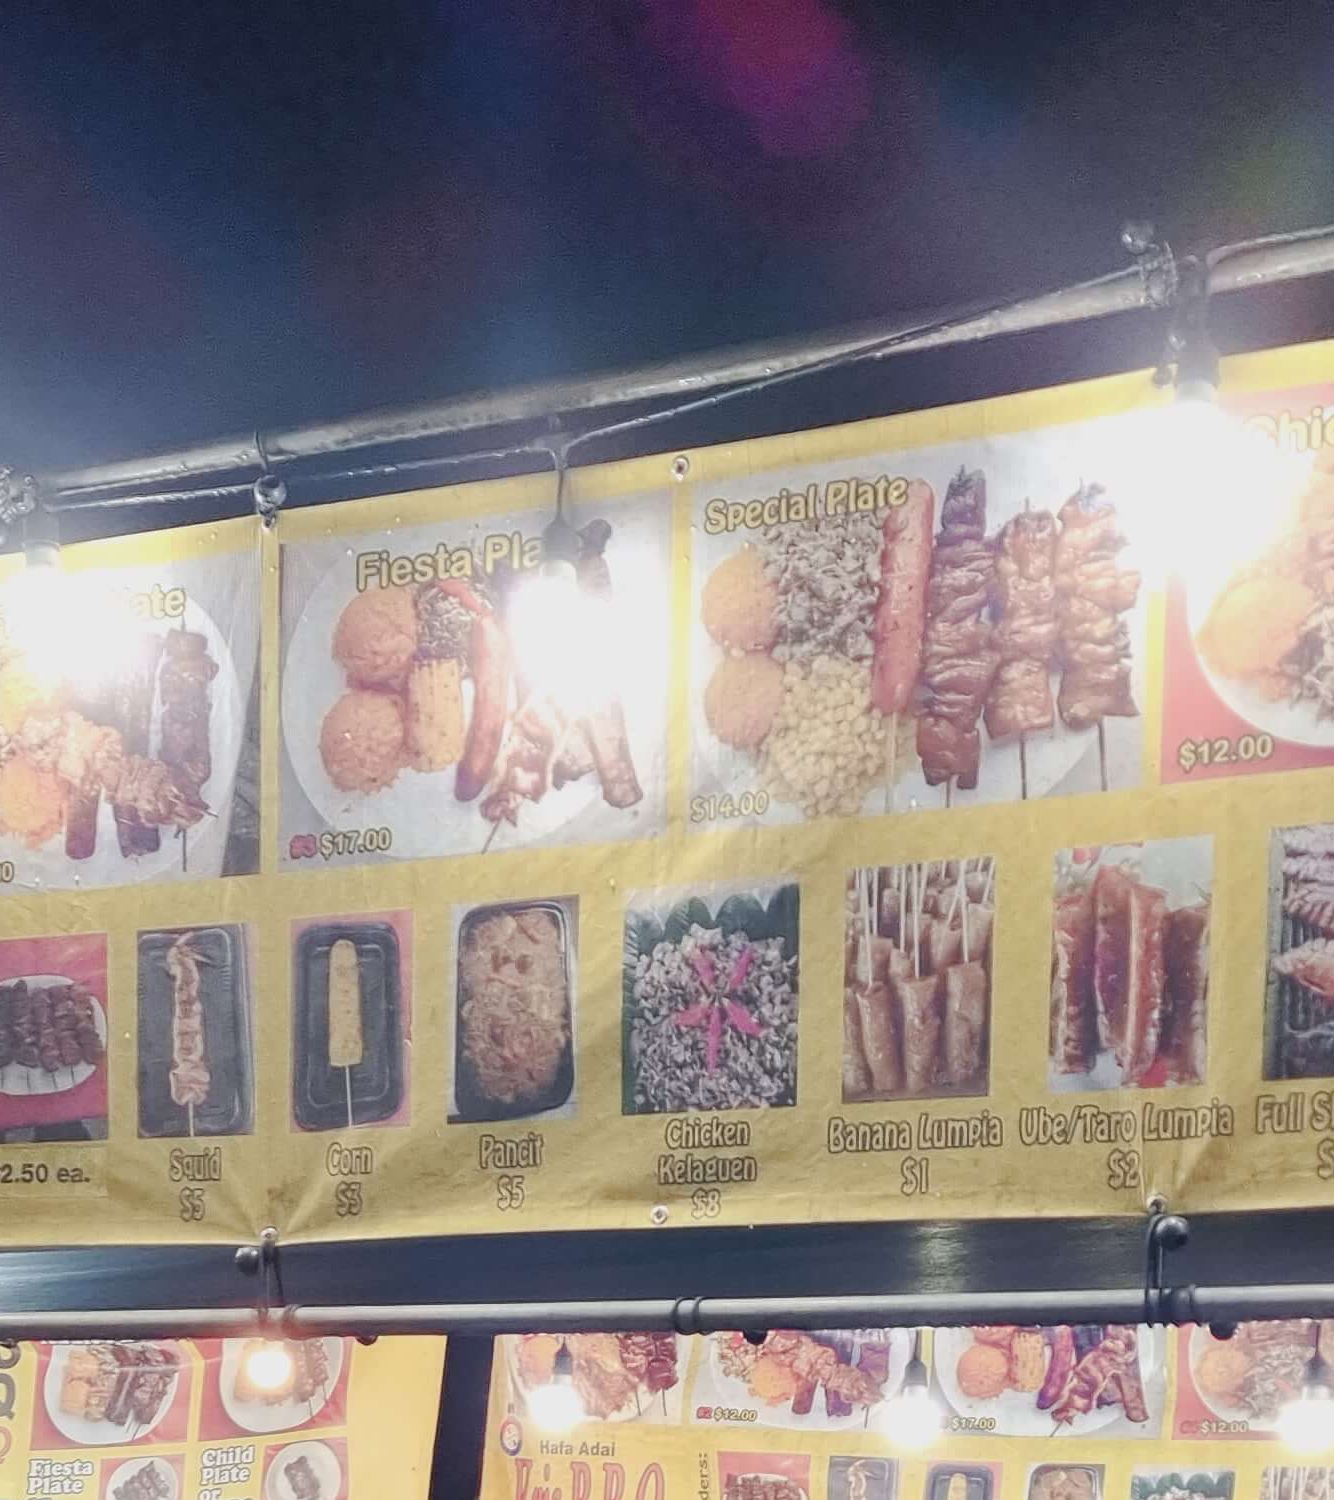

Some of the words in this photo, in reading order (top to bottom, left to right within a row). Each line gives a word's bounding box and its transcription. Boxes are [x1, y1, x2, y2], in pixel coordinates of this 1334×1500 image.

[705, 482, 819, 536] Special
[825, 474, 909, 518] Plate
[355, 542, 475, 592] Fiesta
[1176, 733, 1276, 774] $12.00
[690, 789, 770, 824] $14.00
[319, 827, 393, 860] $17.00
[827, 1116, 913, 1154] Banana
[916, 1108, 1004, 1151] Lumpia
[1017, 1103, 1138, 1147] Ube/Taro
[1141, 1096, 1236, 1142] Lumpia
[1254, 1091, 1307, 1135] Full
[477, 1132, 545, 1172] Pancit
[664, 1117, 752, 1154] Chicken
[55, 1165, 92, 1184] ea.
[168, 1146, 224, 1184] Squid
[325, 1142, 375, 1179] Corn
[656, 1153, 759, 1189] Kelaguen
[899, 1156, 930, 1197] $1
[1106, 1147, 1142, 1192] $2
[177, 1185, 206, 1223] $5
[336, 1181, 365, 1218] $3
[496, 1174, 527, 1213] $5
[690, 1188, 723, 1220] $8
[713, 1405, 758, 1422] $12.00
[949, 1416, 997, 1432] $17.00
[1199, 1419, 1249, 1436] $12.00
[201, 1444, 256, 1467] Child
[538, 1439, 575, 1456] Hafa
[578, 1441, 616, 1458] Adai
[26, 1475, 85, 1496] Plate
[27, 1458, 95, 1479] Fiesta
[198, 1464, 252, 1487] Plate
